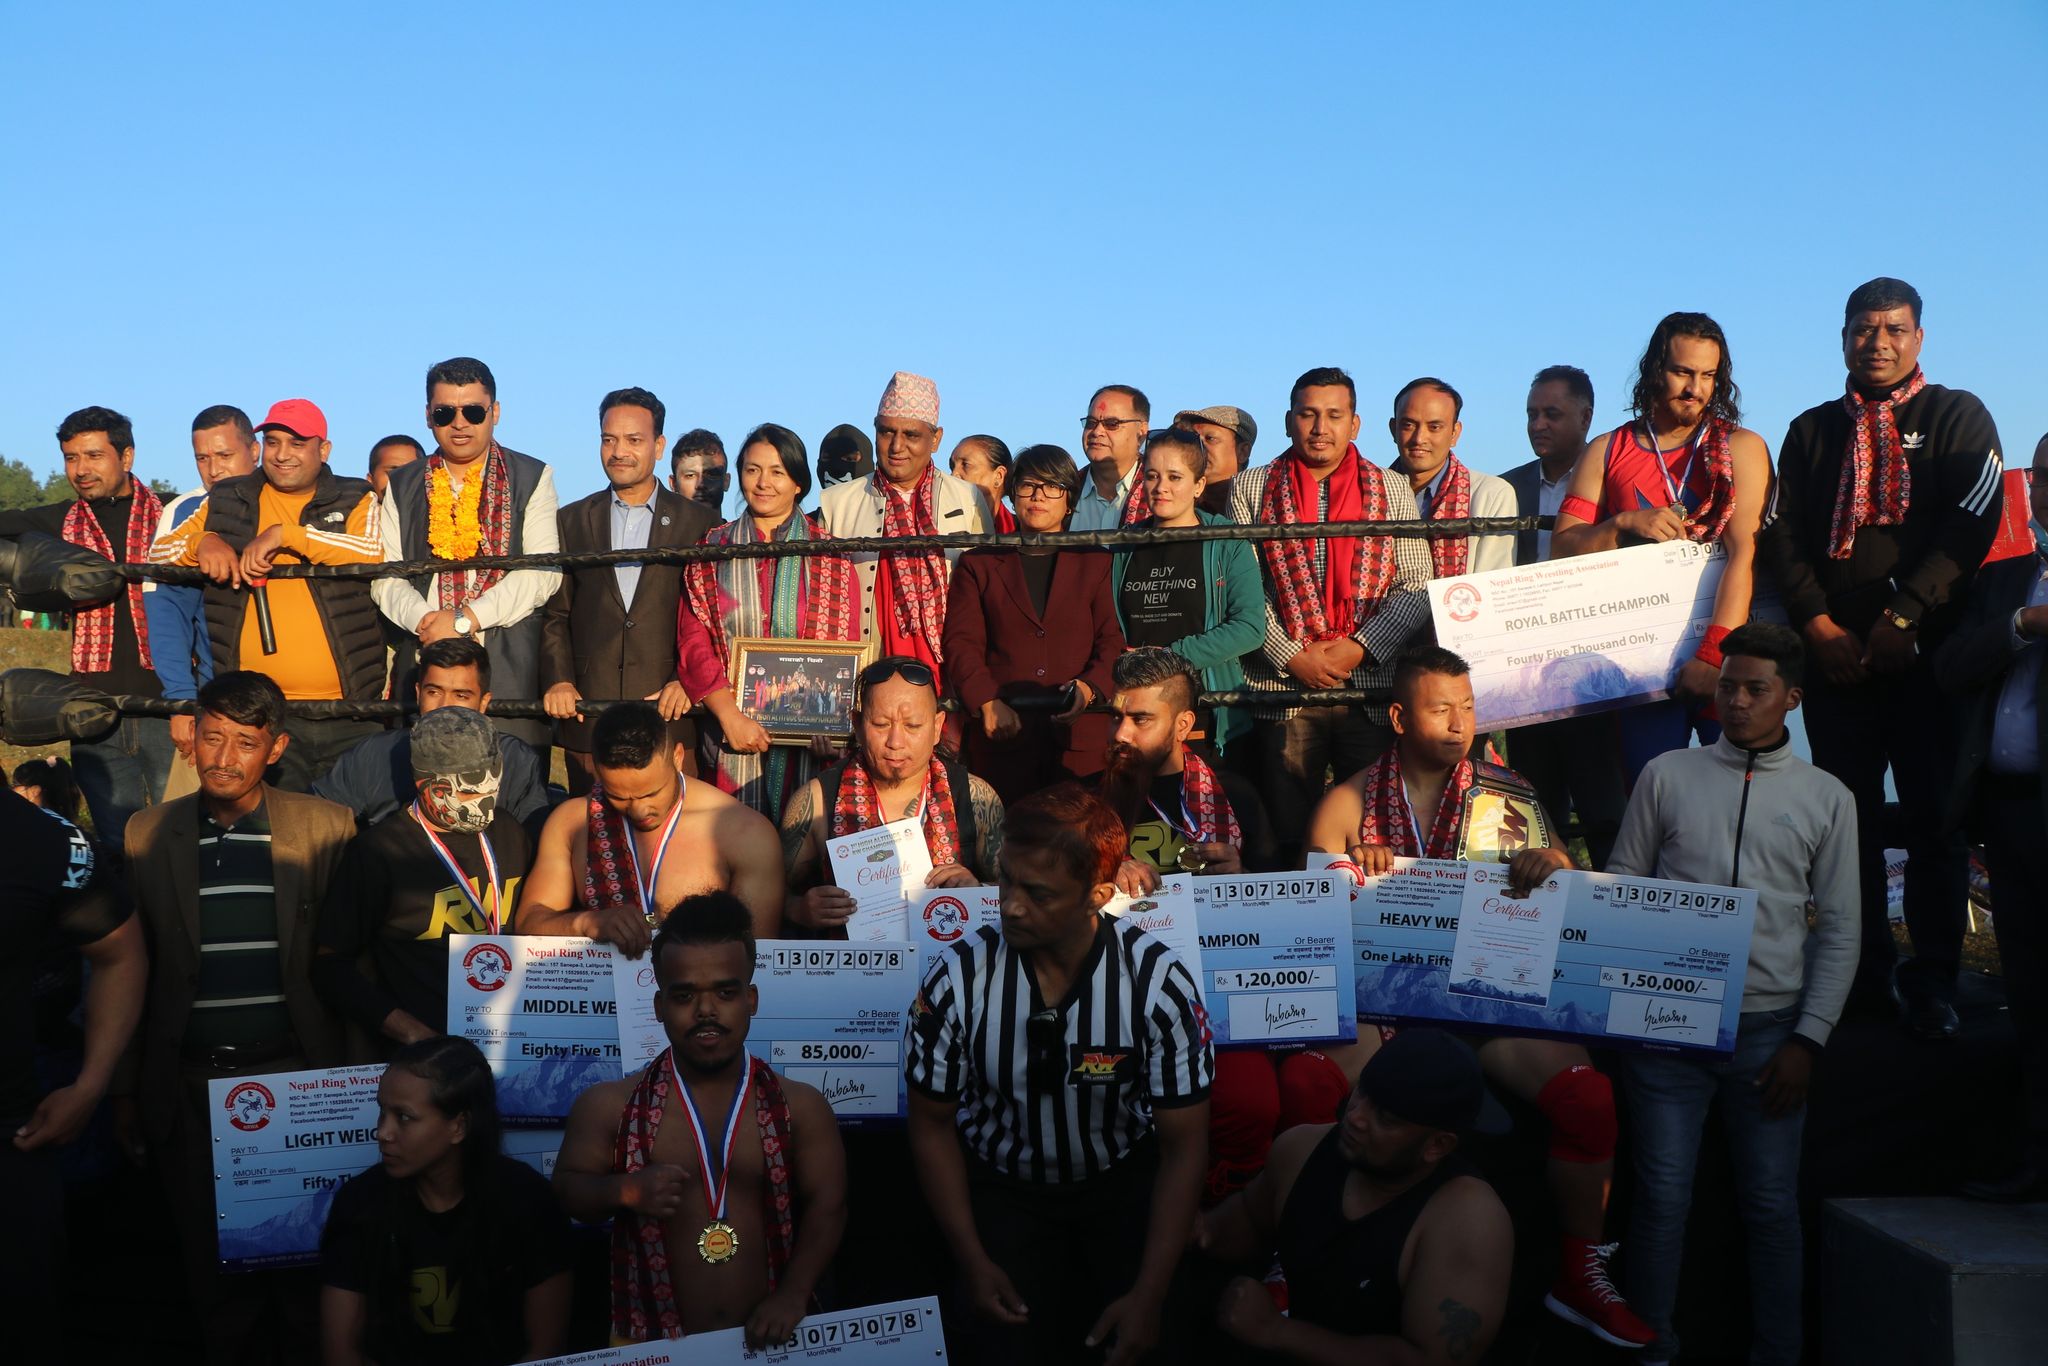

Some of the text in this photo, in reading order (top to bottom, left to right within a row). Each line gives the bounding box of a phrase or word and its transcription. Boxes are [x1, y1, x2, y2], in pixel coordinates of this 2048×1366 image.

[1150, 566, 1175, 578] BUY
[1489, 576, 1513, 588] Nepal
[1515, 573, 1534, 584] Ring
[1535, 567, 1574, 580] Wrestling
[1575, 560, 1619, 574] Association
[1124, 578, 1197, 592] SOMETHING
[1144, 592, 1170, 605] NEW
[1505, 615, 1548, 631] ROYAL
[1549, 606, 1597, 624] BATTLE
[1599, 593, 1670, 615] CHAMPION
[1507, 631, 1659, 667] Fourty Five Thousand Only.
[857, 861, 912, 887] Certificate
[1409, 868, 1432, 879] Ring
[1214, 881, 1330, 899] 13072078
[1594, 885, 1610, 893] Date
[1482, 897, 1542, 921] Certificate
[1380, 912, 1432, 927] HEAVY
[1307, 937, 1335, 945] Bearer
[526, 947, 556, 959] Nepal
[559, 949, 584, 960] Ring
[777, 952, 899, 966] 13072078
[1361, 950, 1388, 962] One
[1391, 951, 1424, 965] Lakh
[1688, 947, 1731, 960] Or Bearer
[1216, 970, 1320, 989] Rs. 1,20,000/-
[1601, 972, 1708, 995] Rs. 1,50,000/-
[523, 1000, 588, 1014] MIDDLE
[591, 1001, 617, 1015] WE
[858, 1010, 900, 1018] Or Bearer
[522, 1043, 621, 1059] Eighty Five Th
[773, 1044, 876, 1061] Rs. 85,000/-
[1073, 1052, 1128, 1074] RW
[288, 1079, 319, 1092] Nepal
[320, 1079, 347, 1089] Ring
[285, 1131, 335, 1149] LIGHT
[231, 1147, 246, 1155] PAY
[232, 1167, 268, 1178] AMOUNT
[303, 1173, 338, 1191] Fifty
[566, 1355, 586, 1365] Sports
